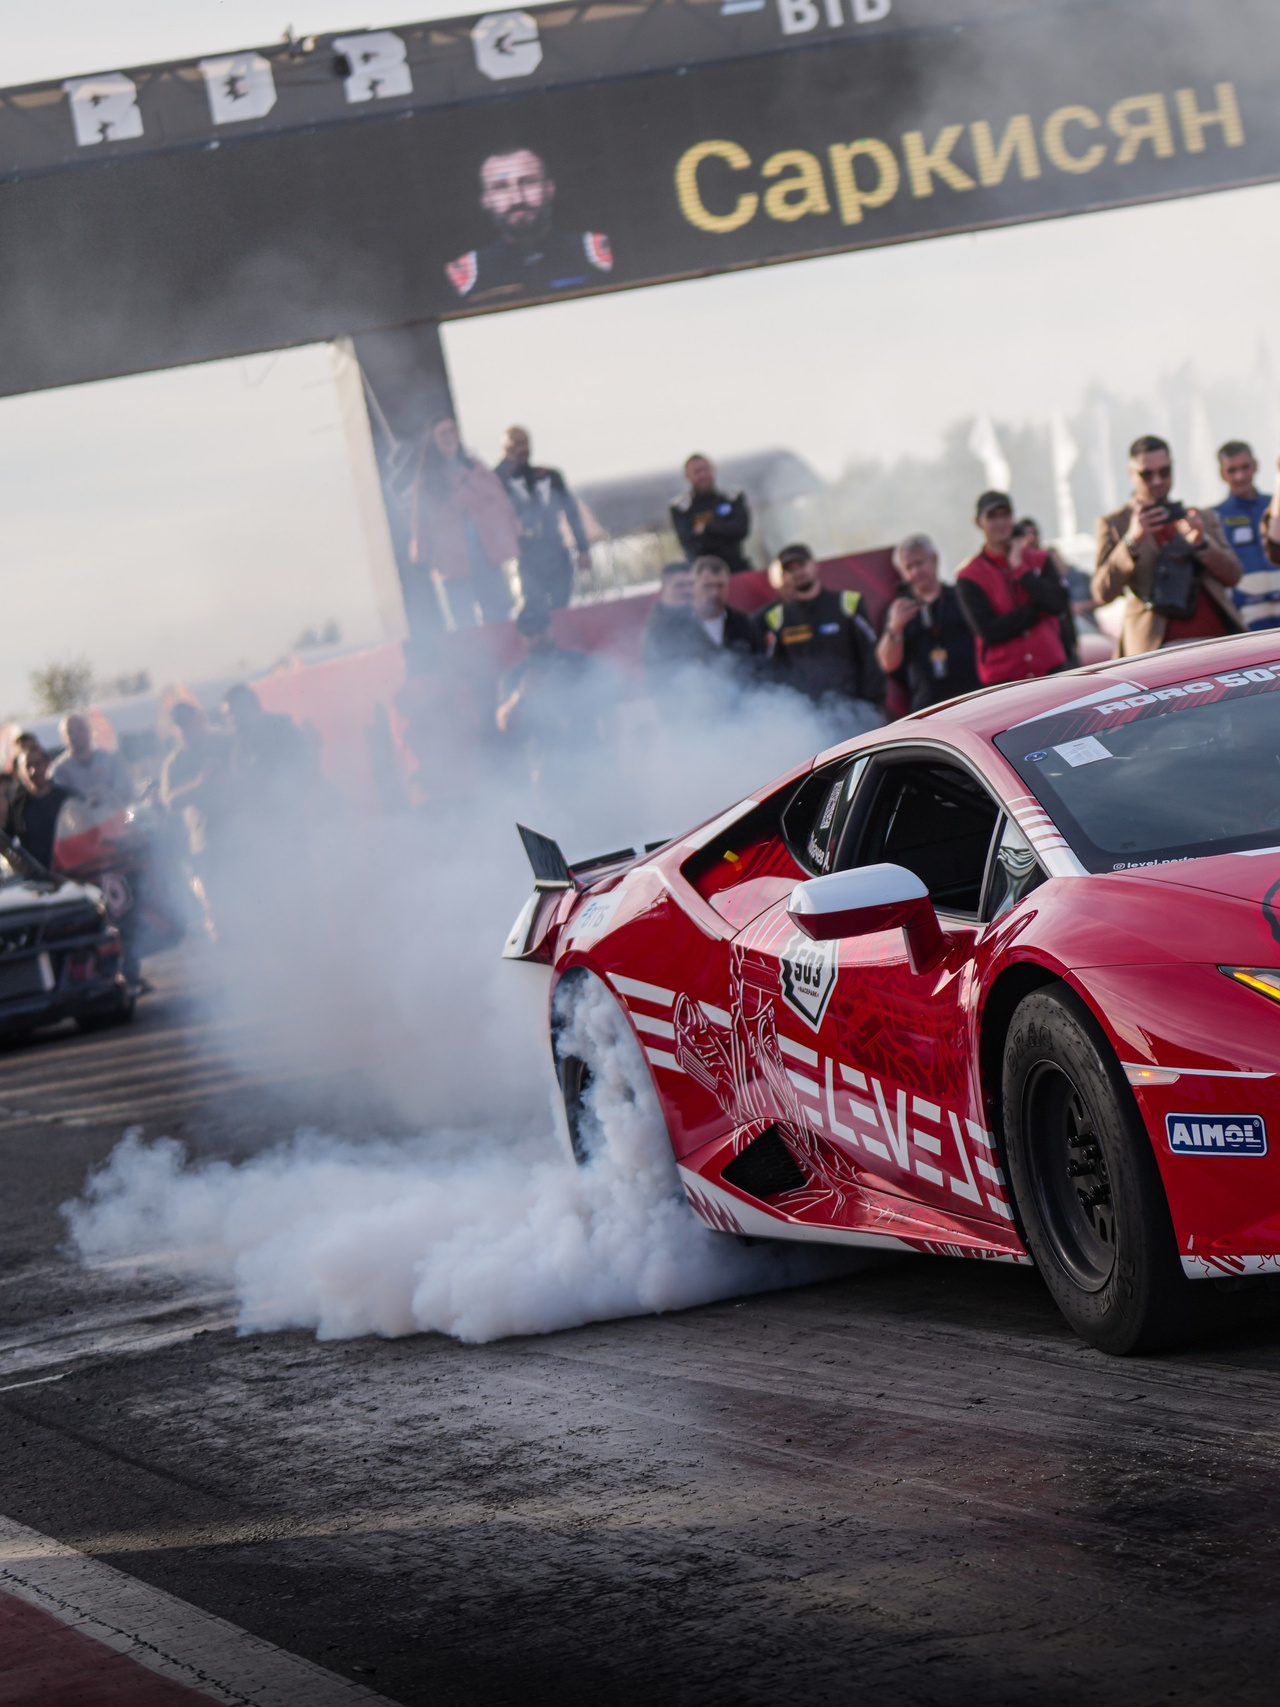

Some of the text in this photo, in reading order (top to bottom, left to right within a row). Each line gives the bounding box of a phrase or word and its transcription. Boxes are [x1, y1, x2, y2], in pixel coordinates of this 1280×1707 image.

[675, 82, 1245, 233] Саркисян
[1093, 682, 1214, 715] RDRC
[794, 948, 825, 988] 503
[1172, 1122, 1262, 1148] AIMOL
